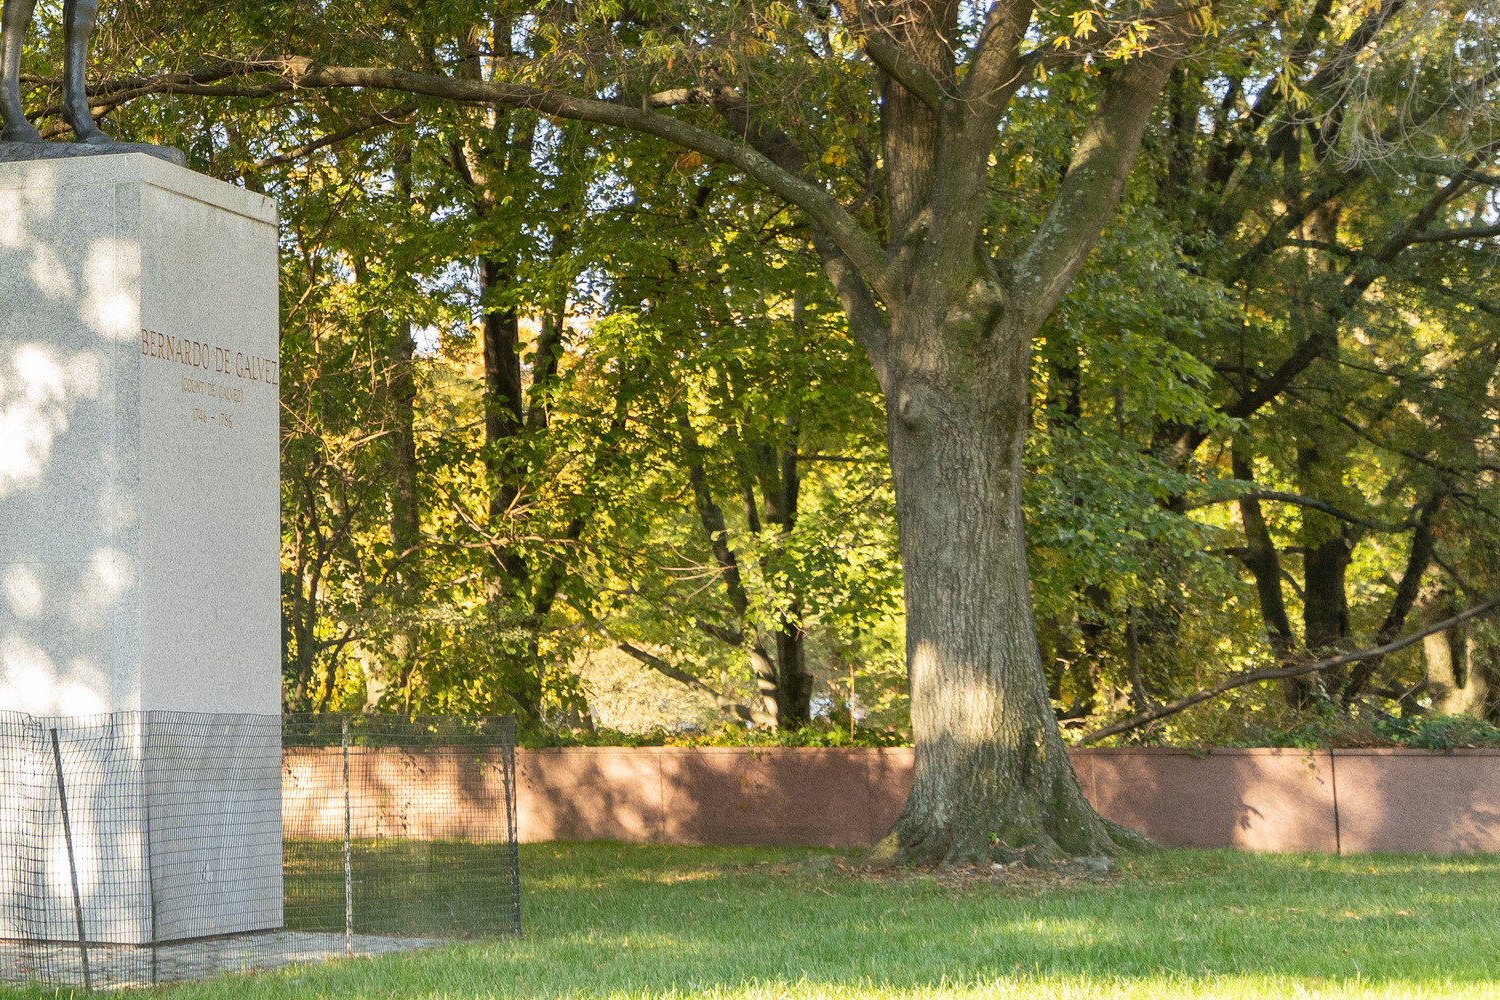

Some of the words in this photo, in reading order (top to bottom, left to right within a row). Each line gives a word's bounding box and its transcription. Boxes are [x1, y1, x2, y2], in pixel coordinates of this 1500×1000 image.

[141, 329, 209, 369] BERNARDO
[216, 347, 230, 374] DE
[236, 352, 278, 385] GALVEZ
[181, 376, 204, 394] (COUNT
[208, 383, 215, 397] DE
[219, 386, 243, 405] GALVEZ)
[193, 408, 207, 423] 1746
